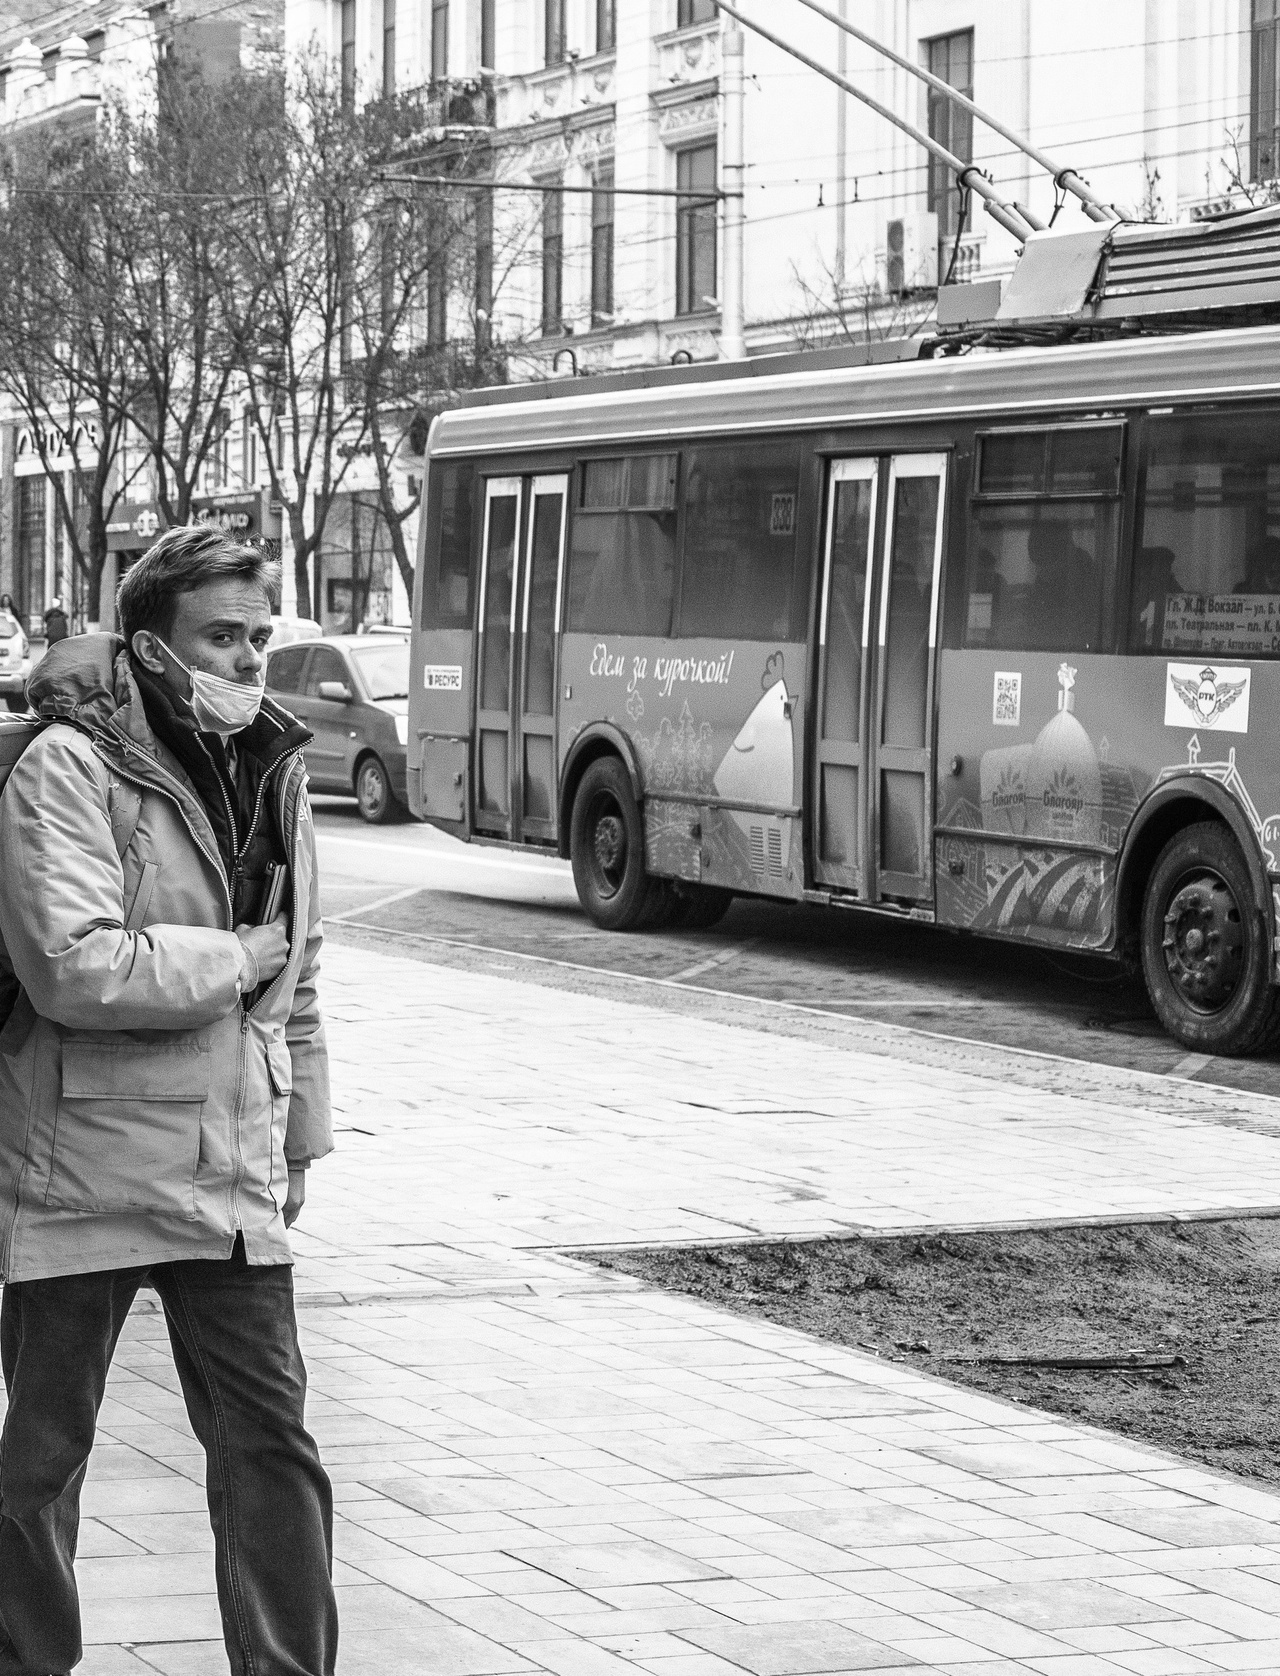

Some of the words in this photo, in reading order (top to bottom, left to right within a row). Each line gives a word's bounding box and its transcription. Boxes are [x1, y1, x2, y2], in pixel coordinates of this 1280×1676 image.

[1208, 599, 1244, 614] Вокзал
[1181, 617, 1235, 633] Театральная
[590, 643, 625, 676] Едем
[627, 656, 647, 692] за
[654, 650, 735, 697] курочкой!
[1199, 692, 1215, 701] РТК
[992, 790, 1026, 808] Благоя
[1043, 789, 1084, 815] Благояр
